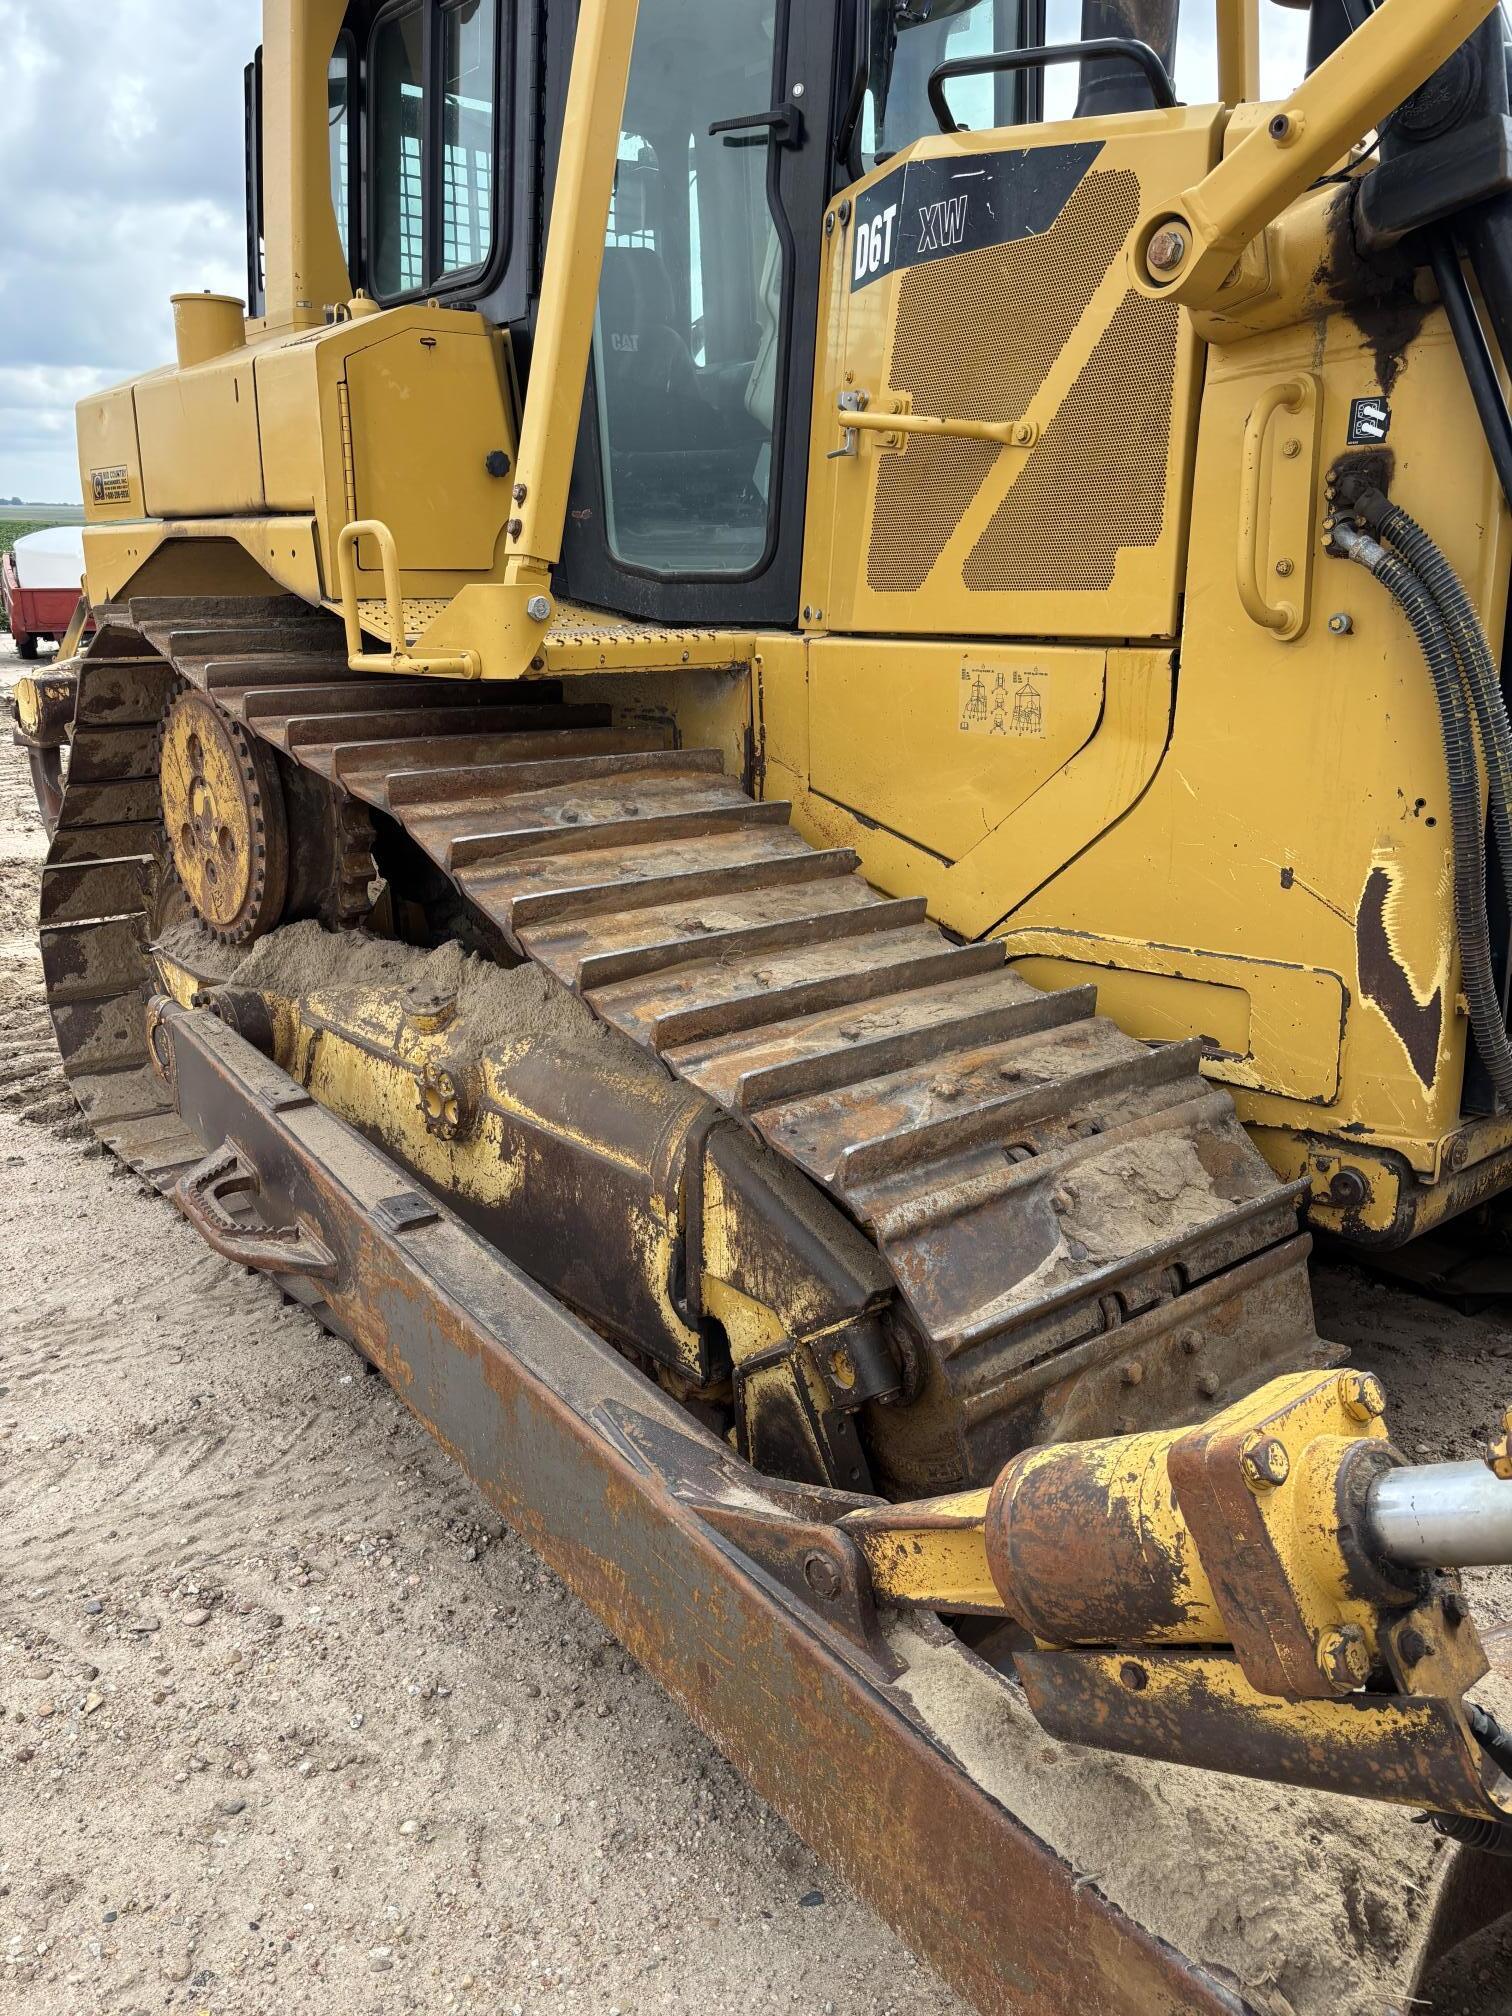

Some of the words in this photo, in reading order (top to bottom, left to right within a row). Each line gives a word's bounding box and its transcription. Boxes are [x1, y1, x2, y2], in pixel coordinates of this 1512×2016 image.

[855, 203, 897, 280] D6T
[917, 195, 968, 253] XW
[611, 333, 639, 351] CAT
